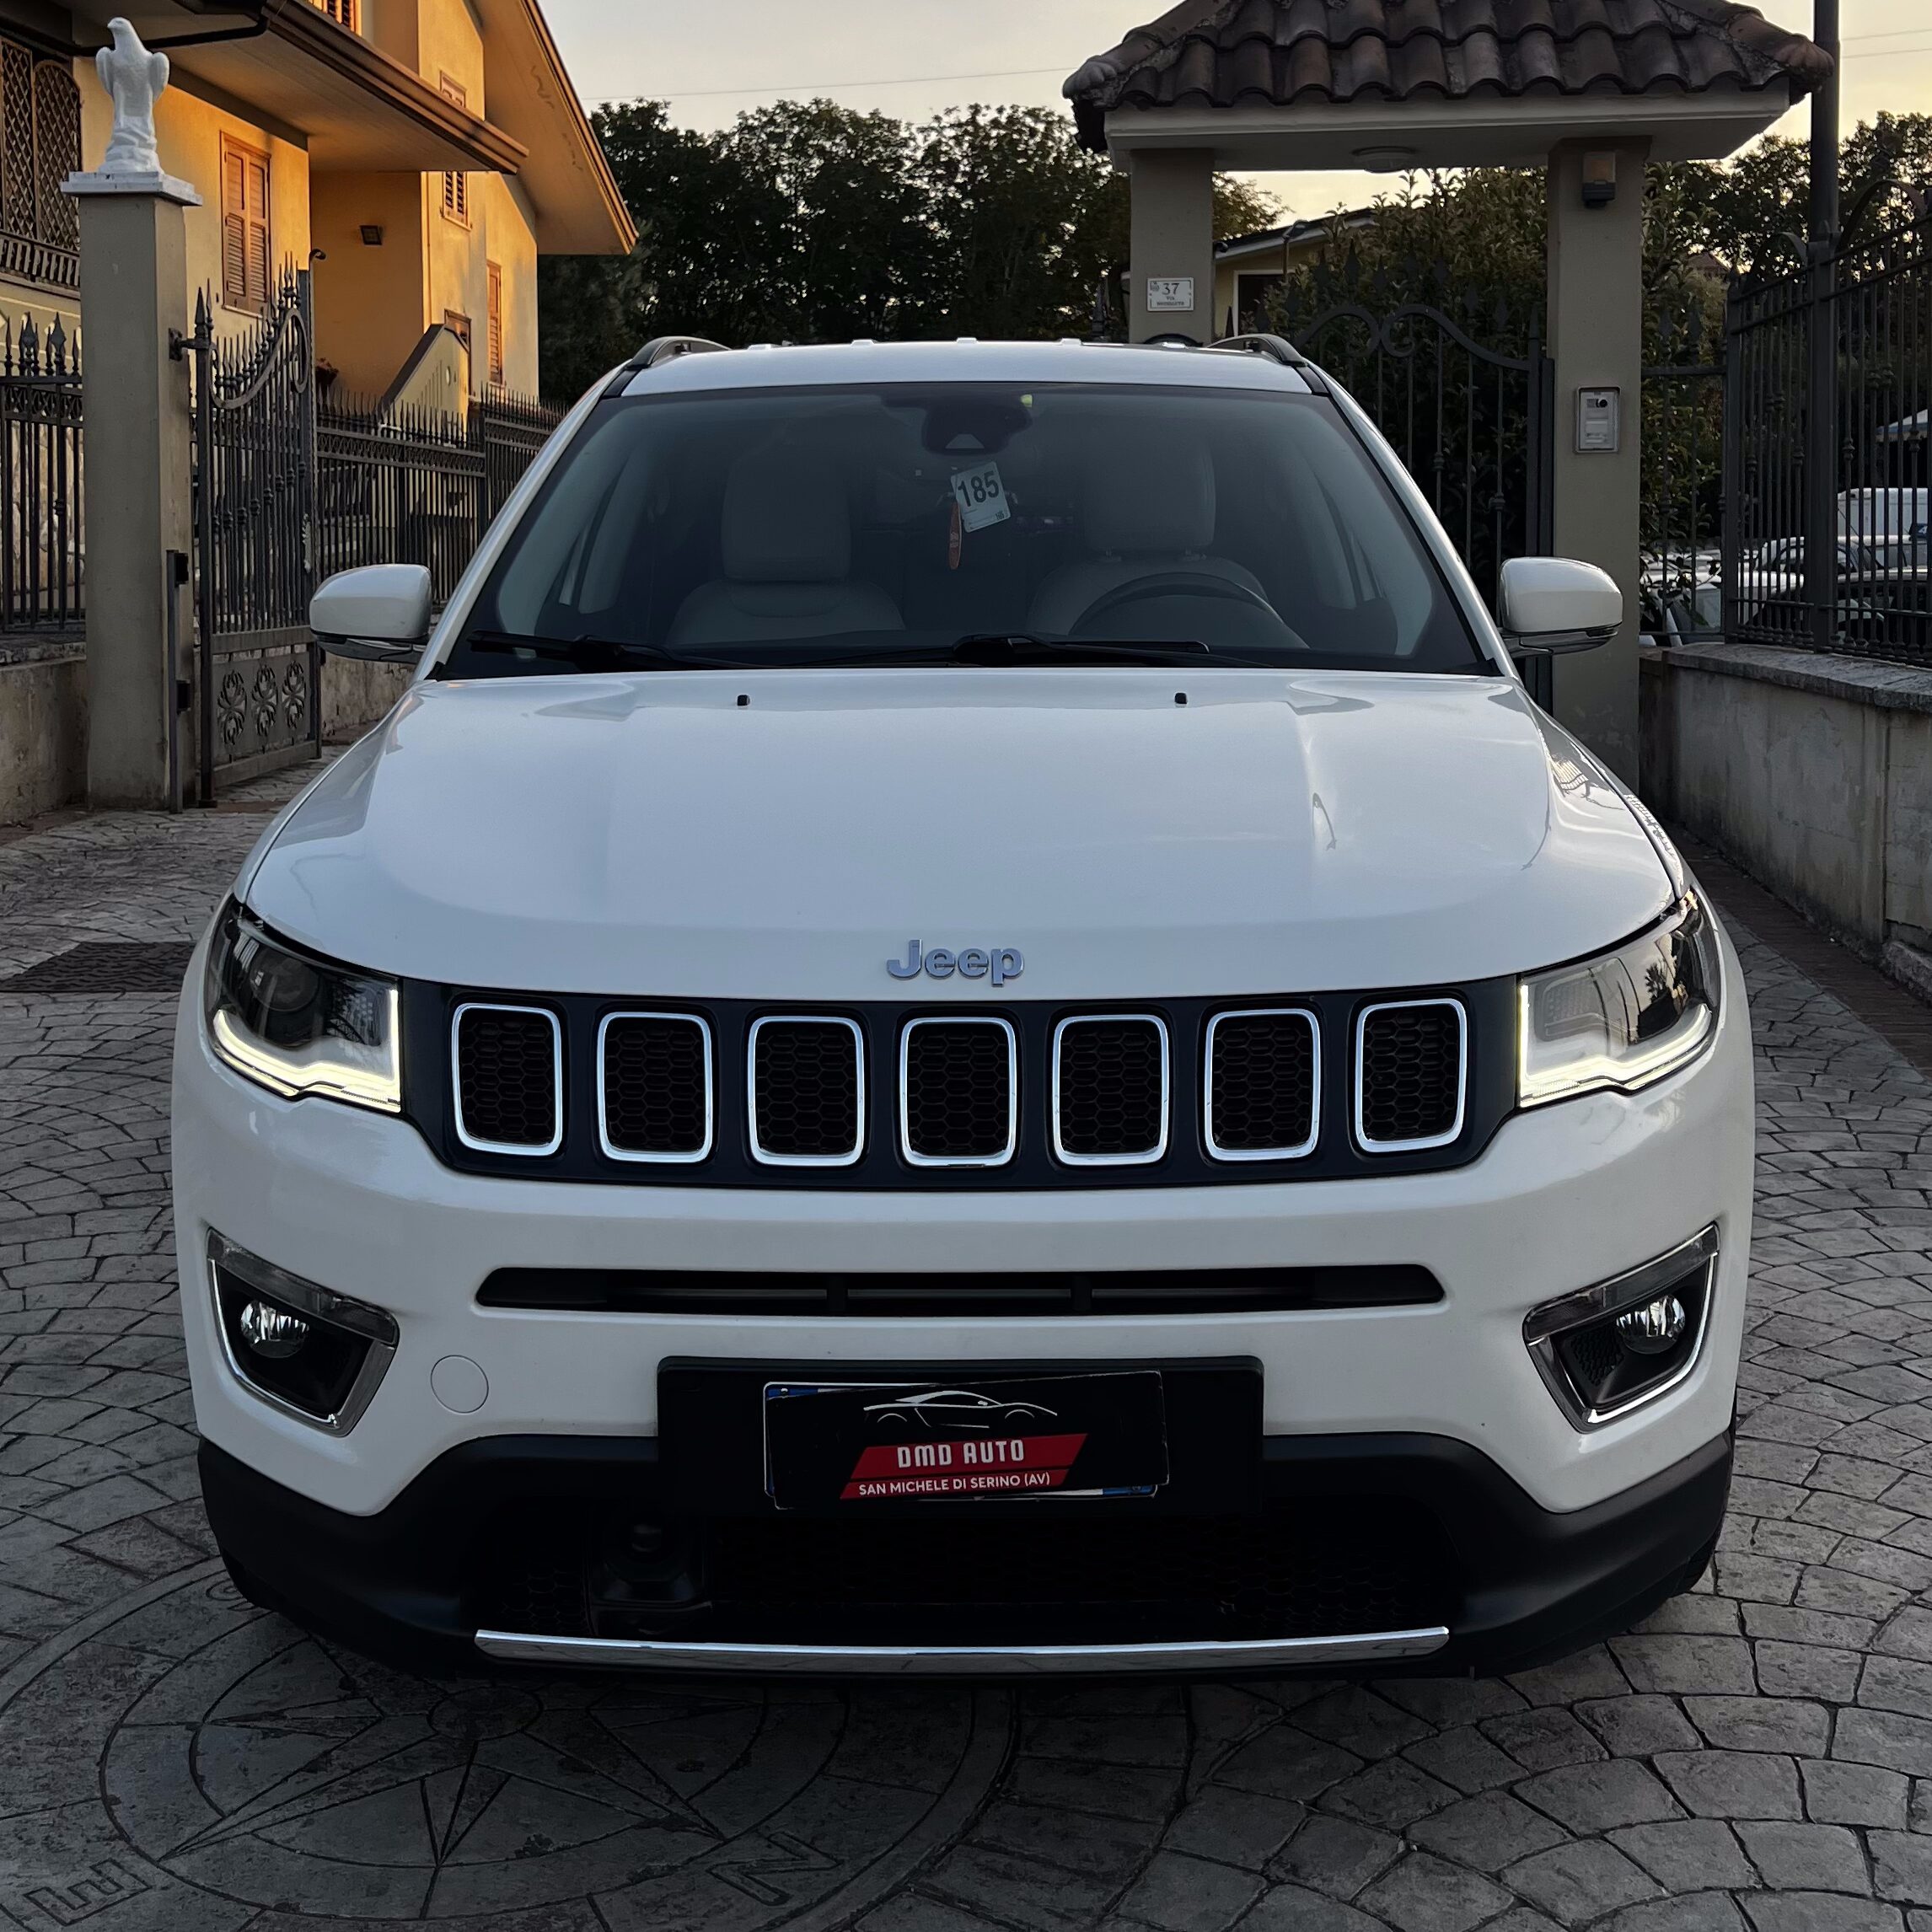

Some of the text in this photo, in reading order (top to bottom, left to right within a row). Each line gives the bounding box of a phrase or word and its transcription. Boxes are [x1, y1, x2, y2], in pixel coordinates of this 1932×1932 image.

[1162, 282, 1180, 295] 37
[958, 470, 1000, 507] 185
[887, 939, 1024, 988] Jeep
[897, 1439, 1025, 1468] DMD AUTO
[859, 1472, 1050, 1496] SAN MICHELE DI SERINO (AV)
